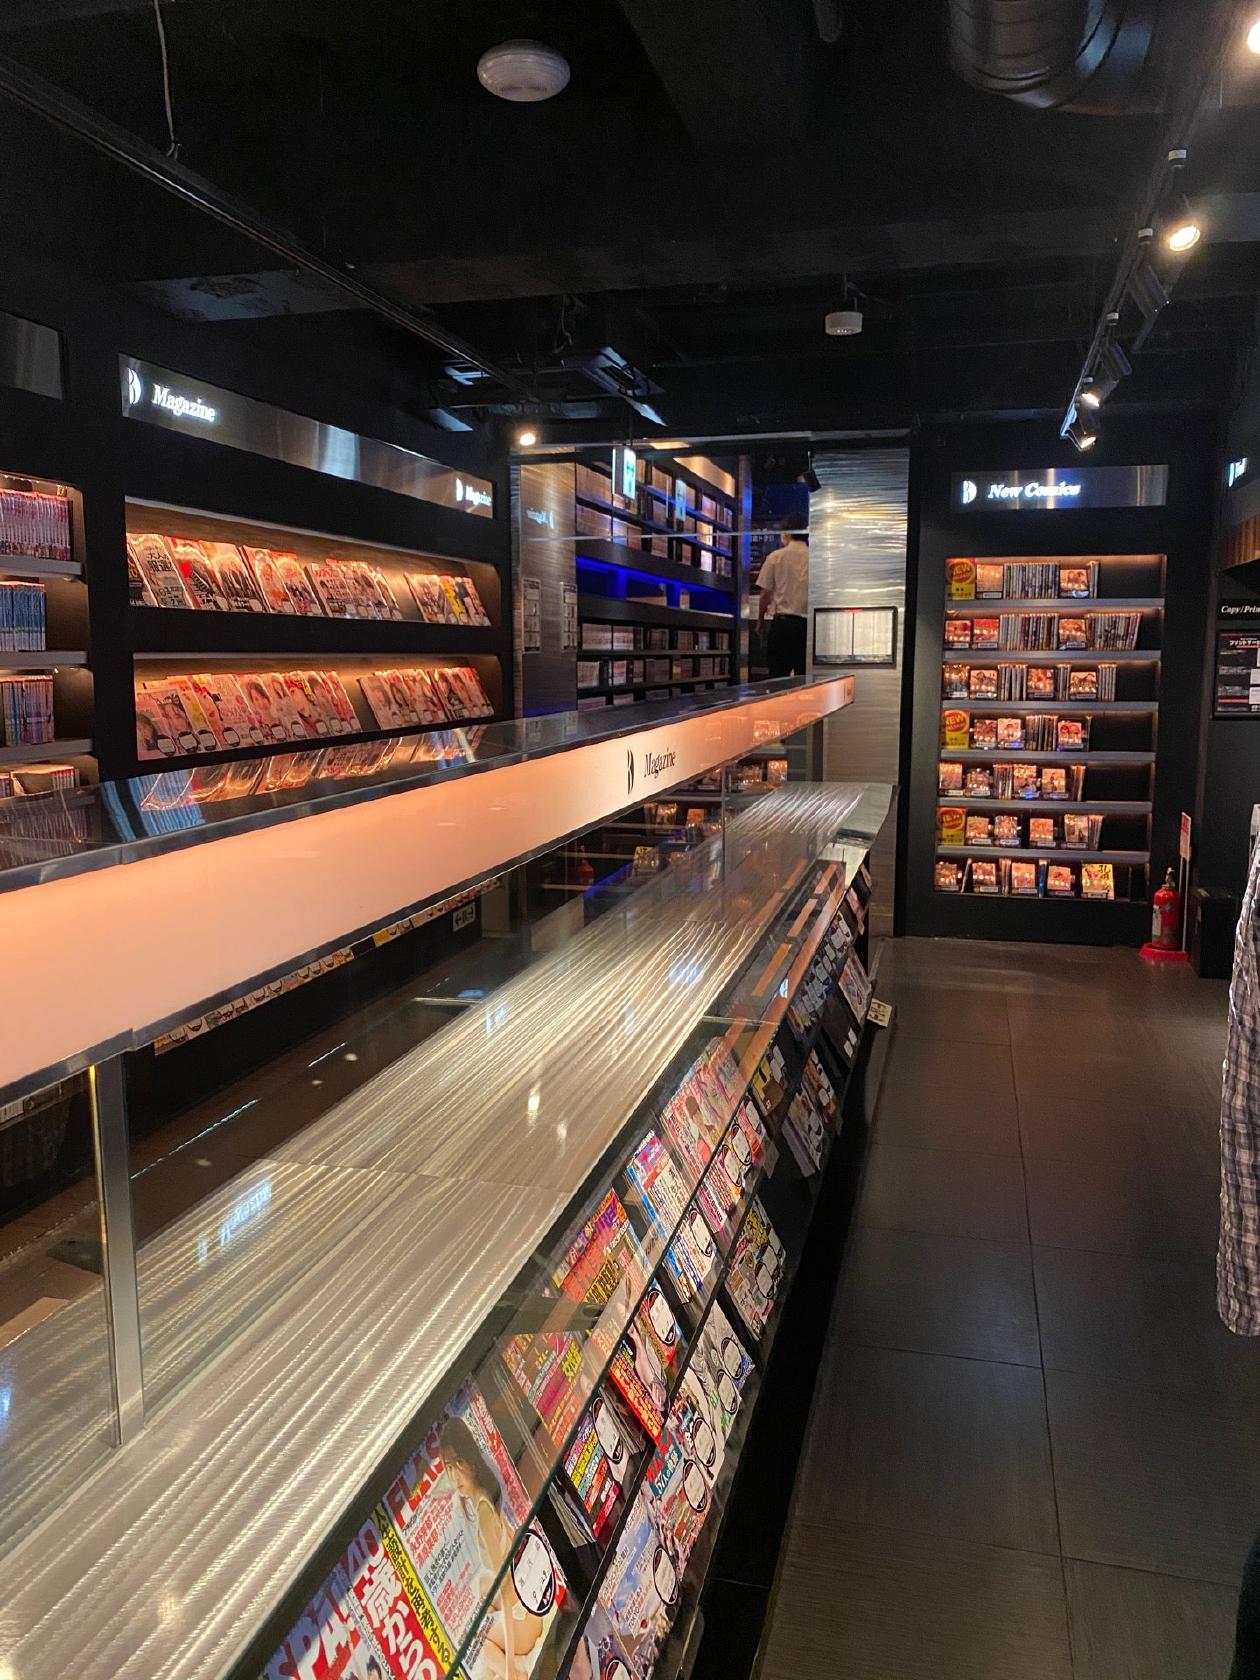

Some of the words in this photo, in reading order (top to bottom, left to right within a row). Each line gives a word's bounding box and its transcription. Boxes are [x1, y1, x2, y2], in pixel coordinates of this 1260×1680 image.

[152, 383, 216, 422] Magazine
[988, 484, 1023, 499] New
[1025, 481, 1081, 498] Comics
[643, 746, 676, 779] Magazine
[383, 1418, 452, 1530] FLAS
